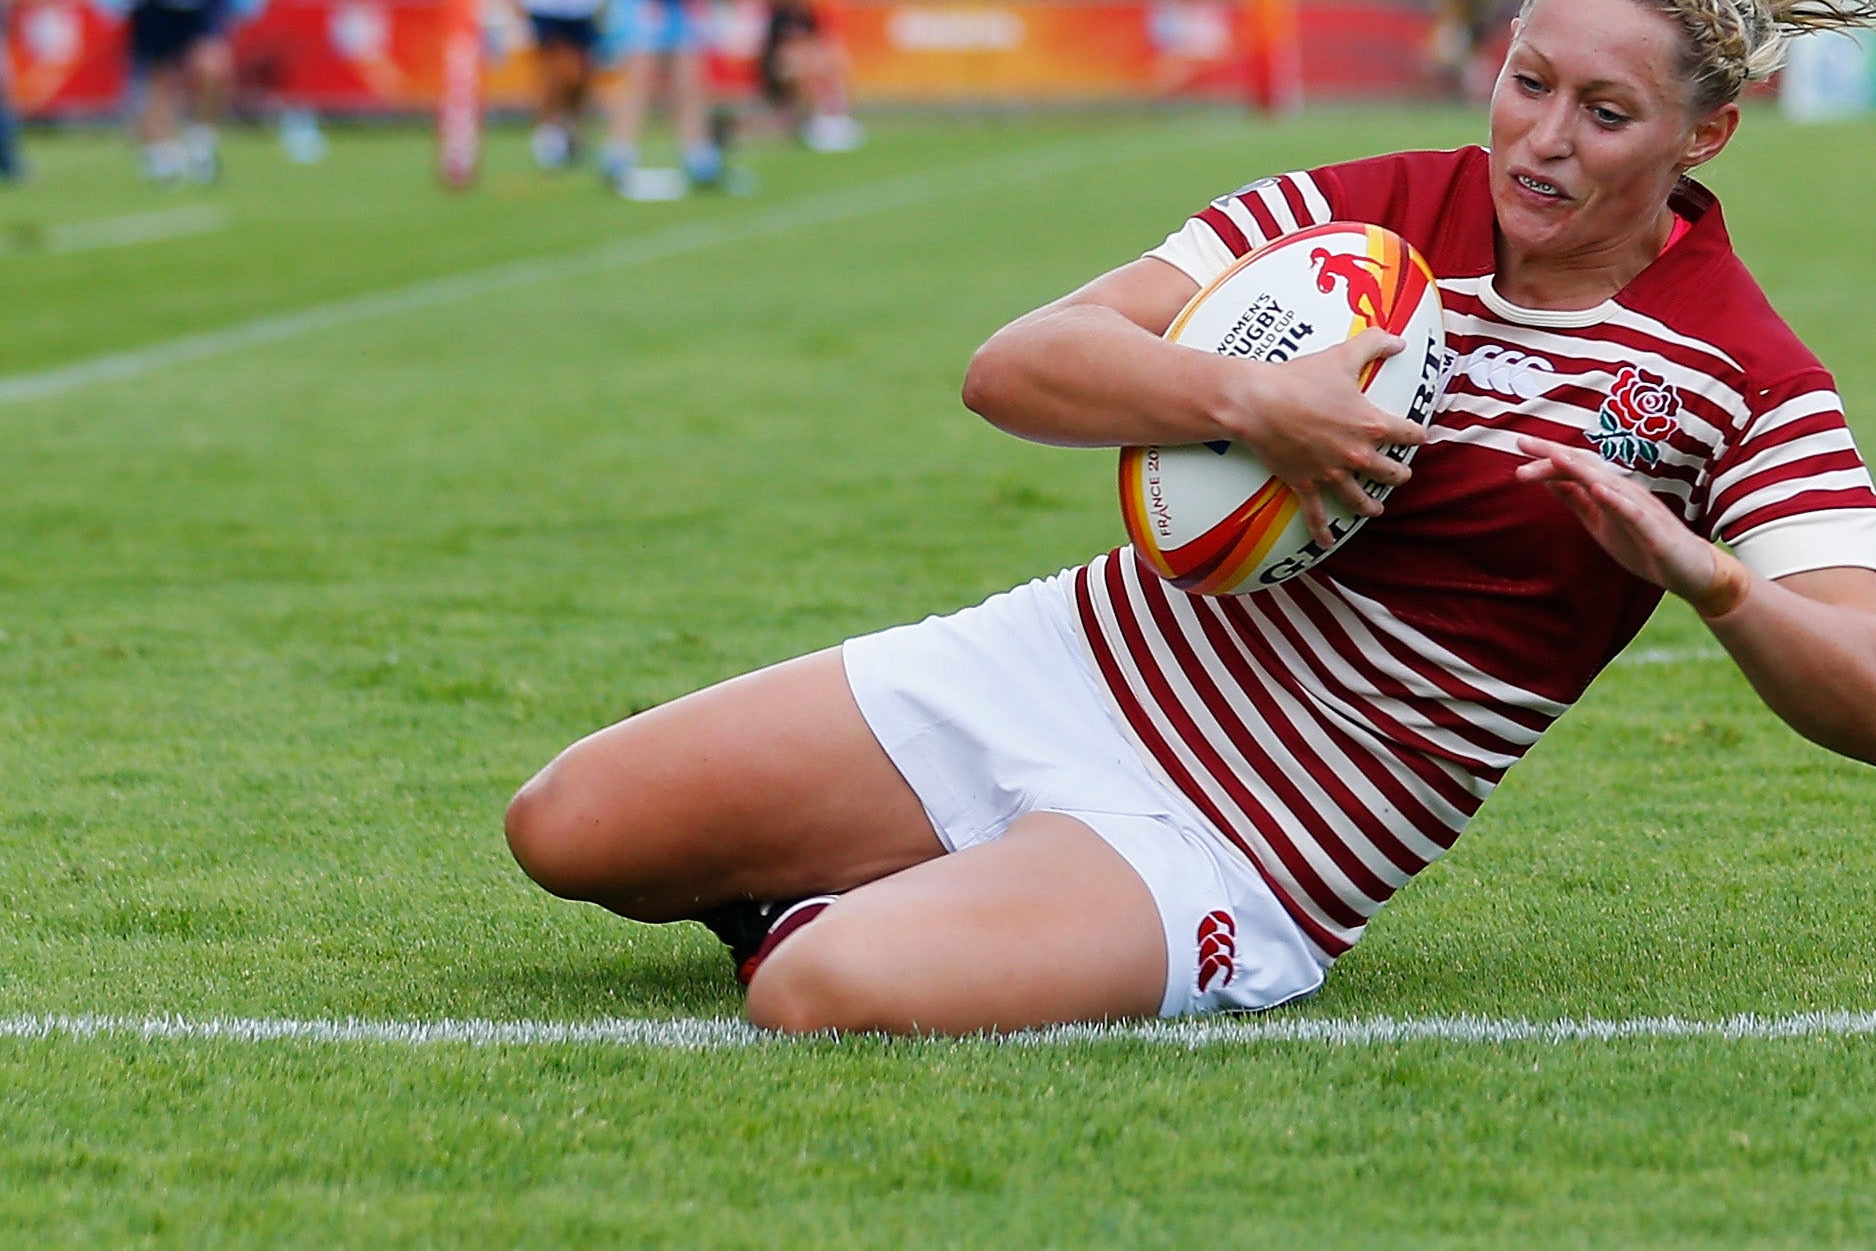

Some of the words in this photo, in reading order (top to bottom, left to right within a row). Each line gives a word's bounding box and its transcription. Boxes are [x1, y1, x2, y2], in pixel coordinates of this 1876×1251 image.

[1227, 300, 1283, 356] UGBY
[1249, 332, 1276, 360] ORLD
[1273, 310, 1295, 334] CUP
[1265, 322, 1314, 362] 014
[1148, 445, 1160, 472] 201
[1149, 477, 1172, 537] FRANCE
